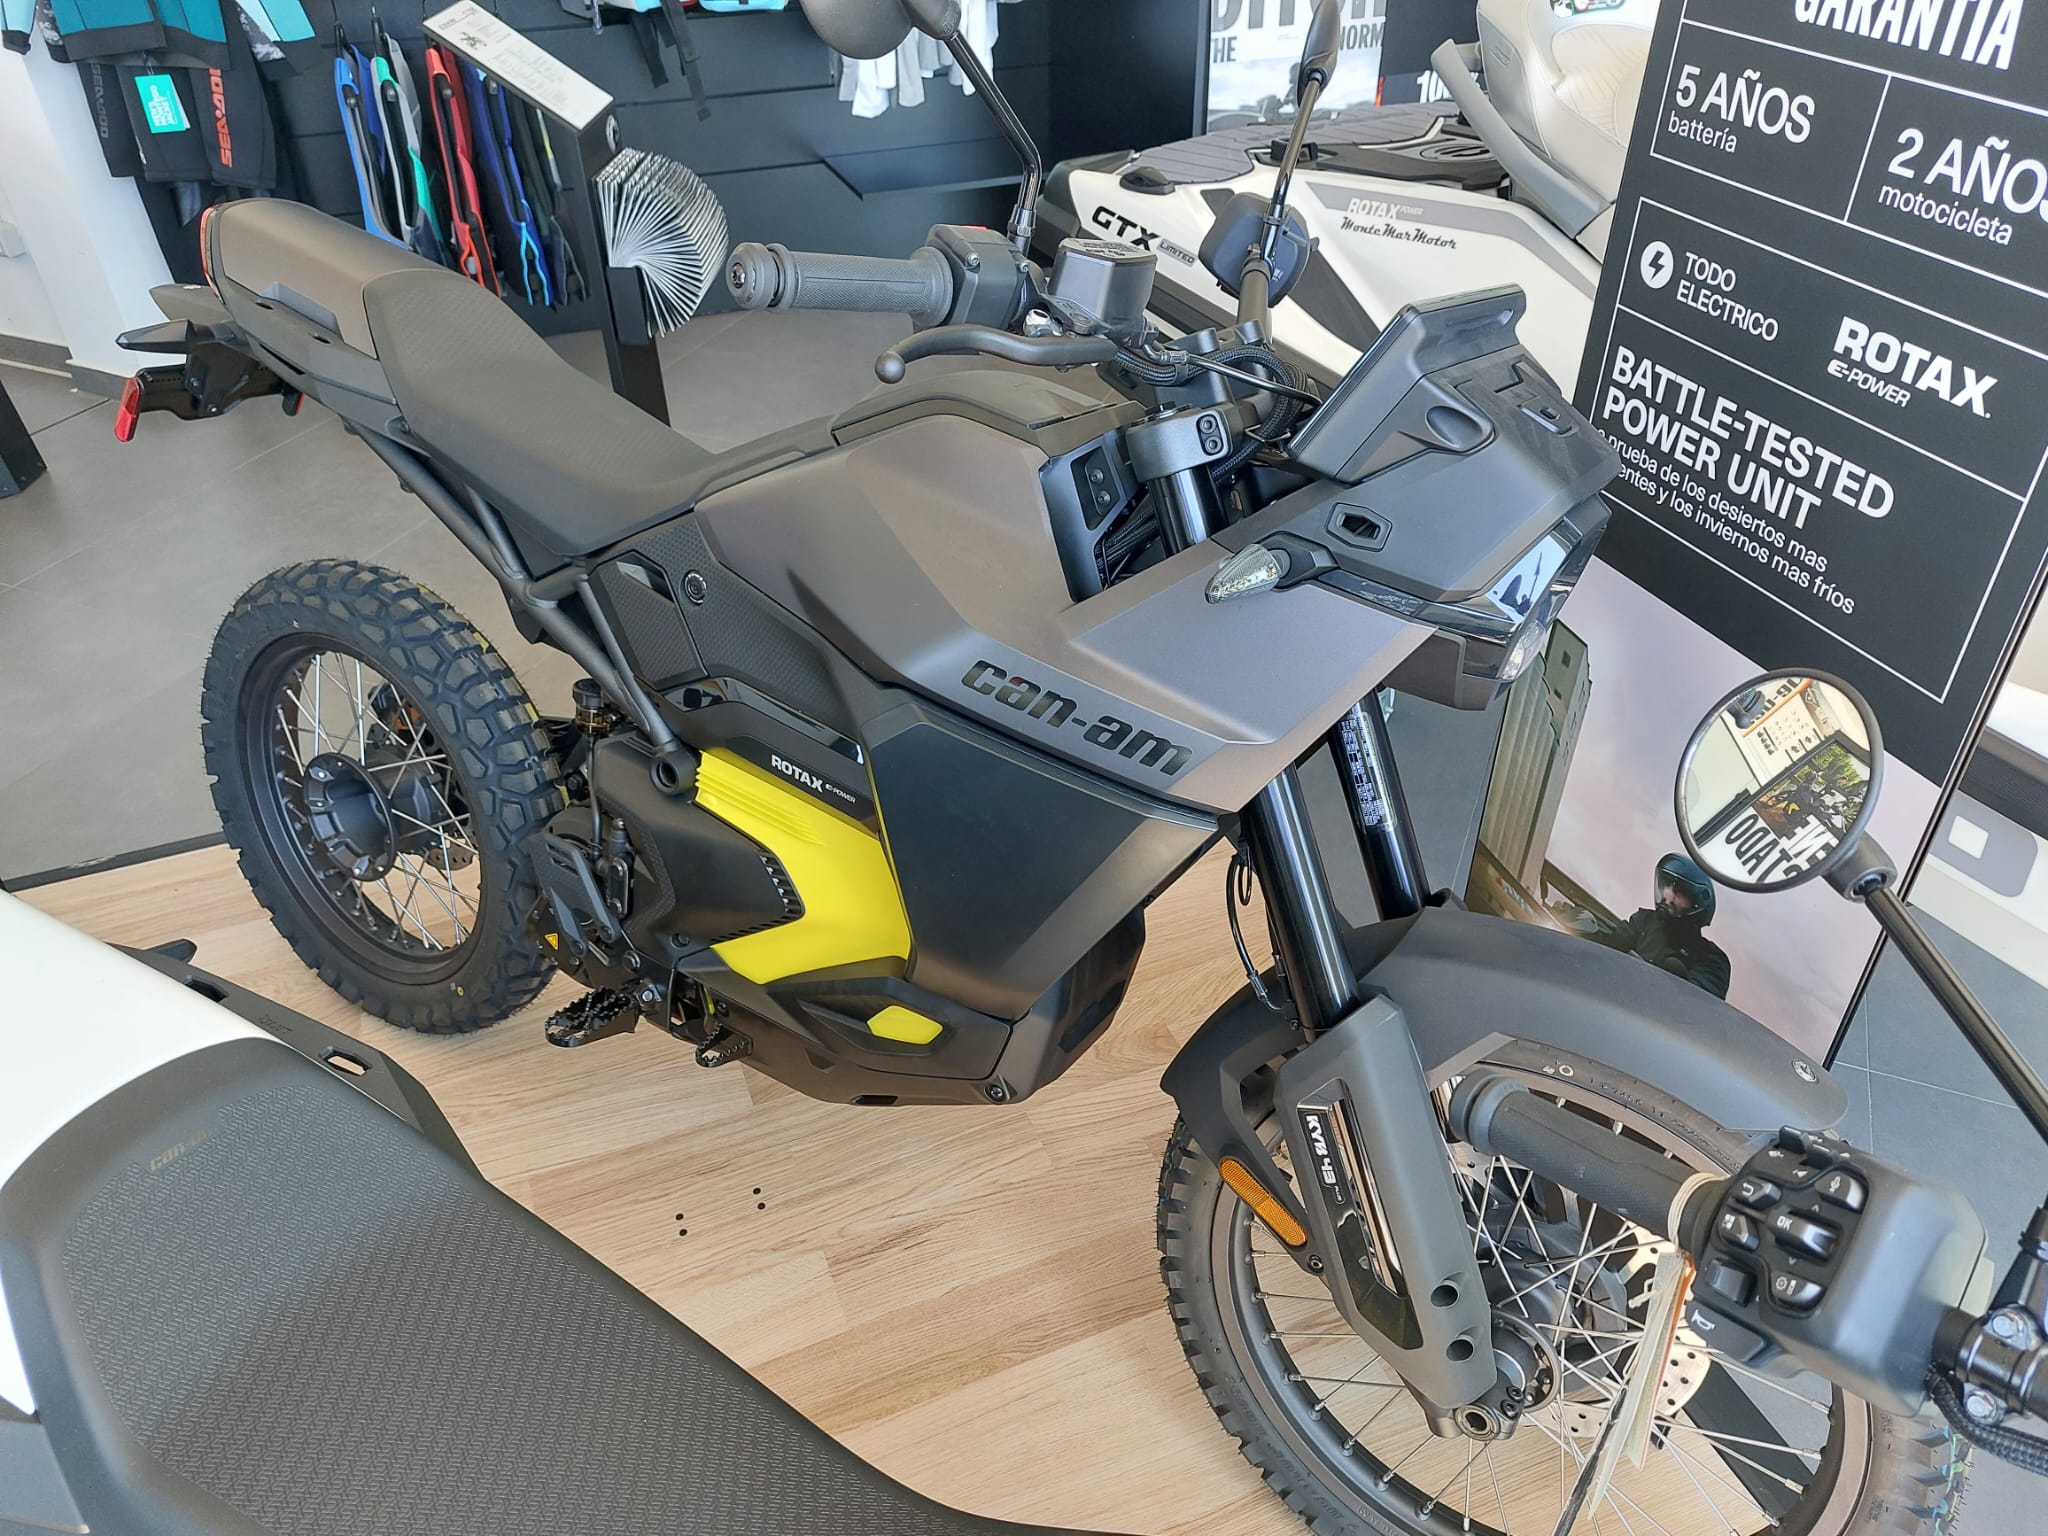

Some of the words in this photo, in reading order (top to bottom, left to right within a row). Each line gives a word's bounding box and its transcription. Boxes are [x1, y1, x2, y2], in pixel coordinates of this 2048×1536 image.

[1668, 110, 1738, 153] battería
[1676, 64, 1700, 107] 5
[1701, 67, 1815, 143] AÑOS
[1888, 128, 1924, 179] 2
[1923, 136, 2048, 223] AÑO
[1092, 206, 1160, 251] GTX
[1347, 198, 1400, 220] ROTAX
[1878, 185, 2013, 245] motocicleta
[1159, 240, 1196, 265] LIMITED
[1684, 251, 1737, 289] TODO
[1676, 280, 1779, 343] ELECTRICO
[1827, 359, 1911, 408] E-POWER
[1834, 316, 1998, 417] ROTAX
[1603, 386, 1721, 480] POWER
[1728, 457, 1822, 530] UNIT
[1612, 345, 1894, 519] BATTLE-TESTED
[1660, 464, 1680, 486] de
[1682, 474, 1706, 502] los
[1708, 492, 1785, 548] desiertos
[1787, 539, 1828, 572] mas
[1656, 487, 1669, 505] y
[1670, 490, 1693, 518] los
[1695, 505, 1769, 563] inviernos
[1771, 554, 1810, 588] mas
[1812, 576, 1855, 614] fríos
[961, 659, 1193, 776] can-am
[771, 754, 823, 793] ROTAX
[1306, 1115, 1328, 1156] KYB
[1776, 1215, 1793, 1230] OK
